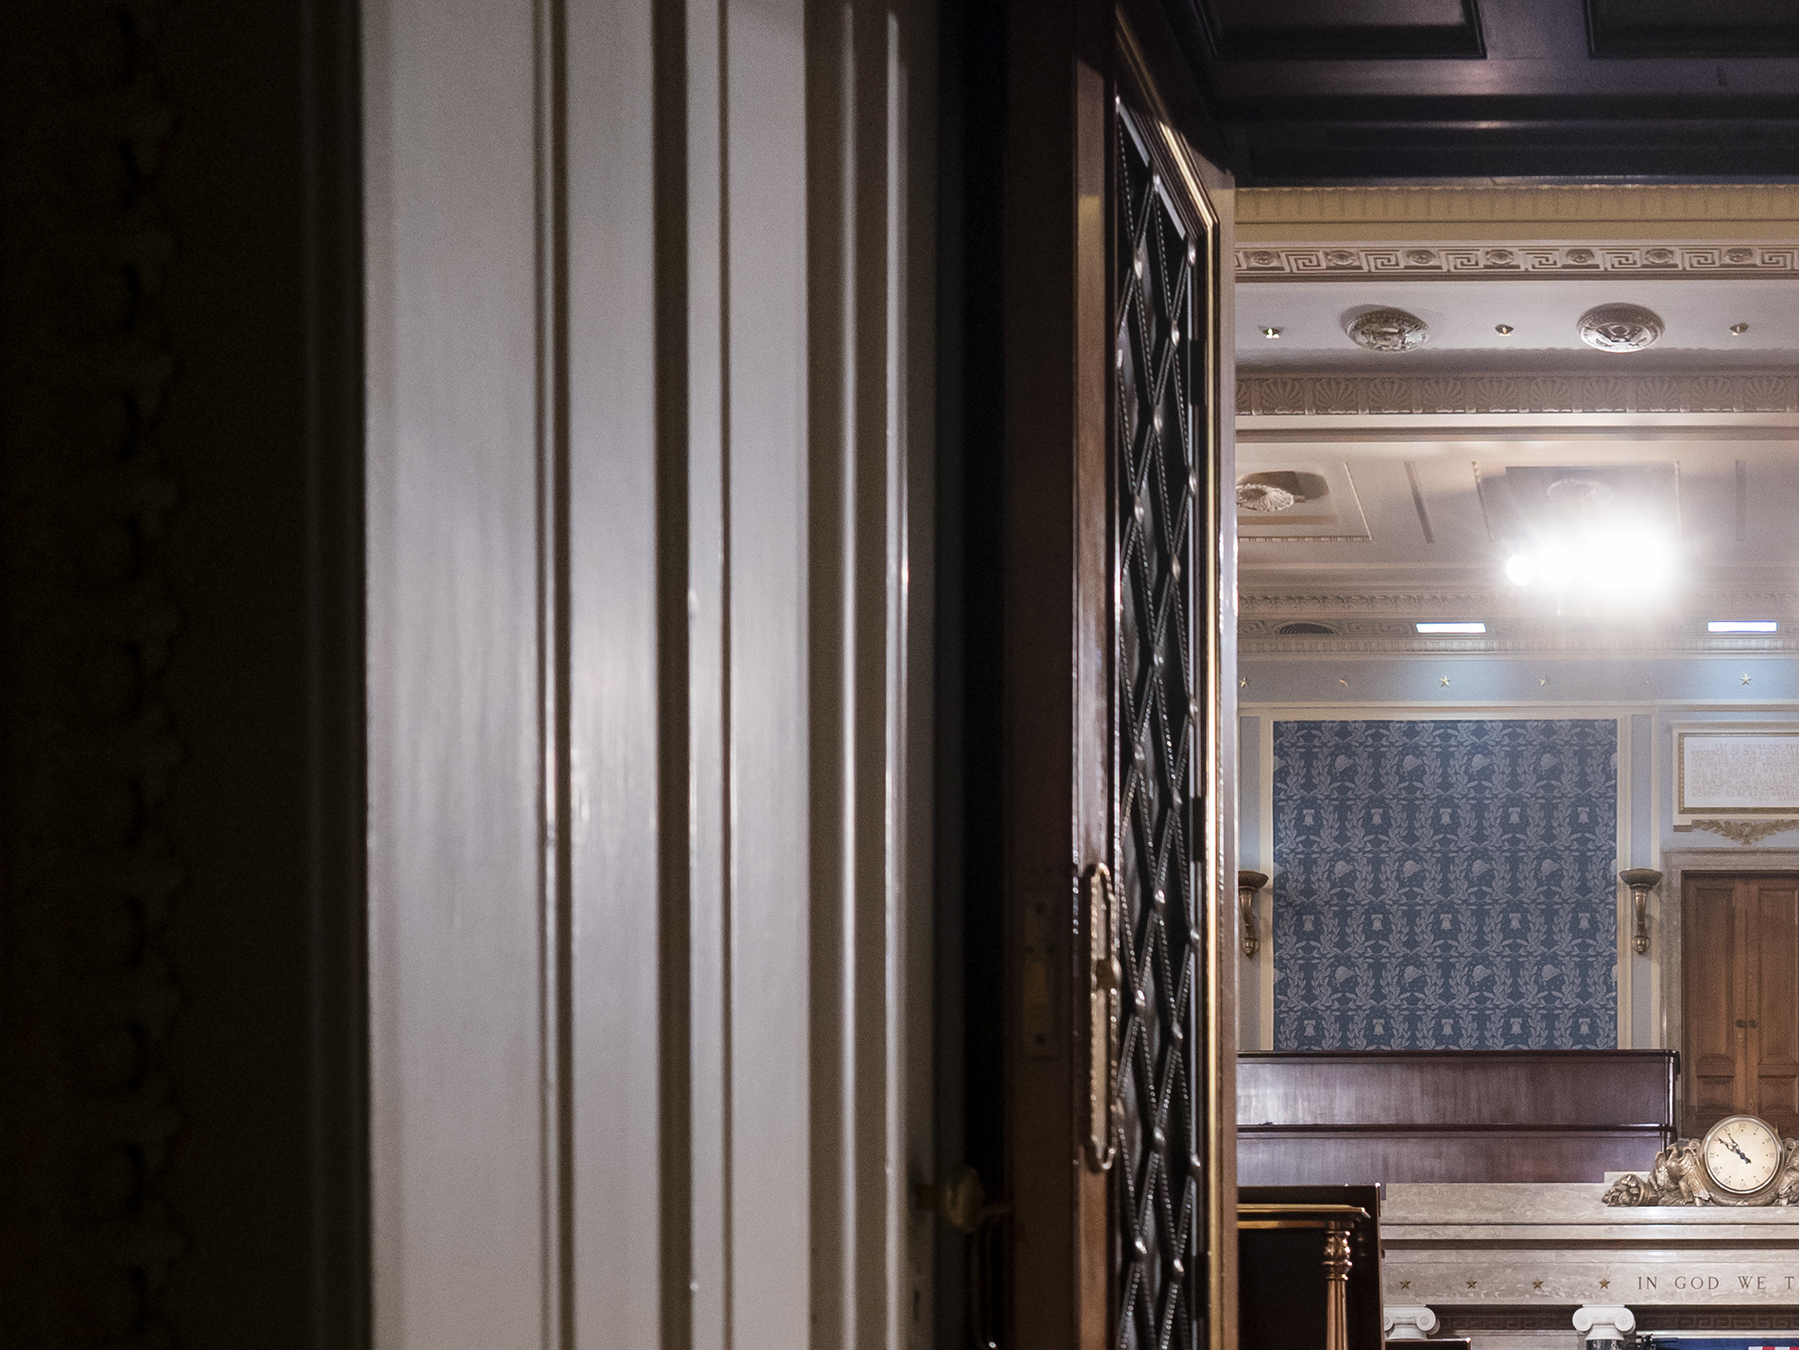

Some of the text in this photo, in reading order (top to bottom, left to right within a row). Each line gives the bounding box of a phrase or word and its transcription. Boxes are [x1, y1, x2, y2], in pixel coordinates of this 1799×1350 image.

[1638, 1276, 1658, 1290] IN
[1674, 1276, 1720, 1290] GOD
[1737, 1276, 1767, 1290] WE
